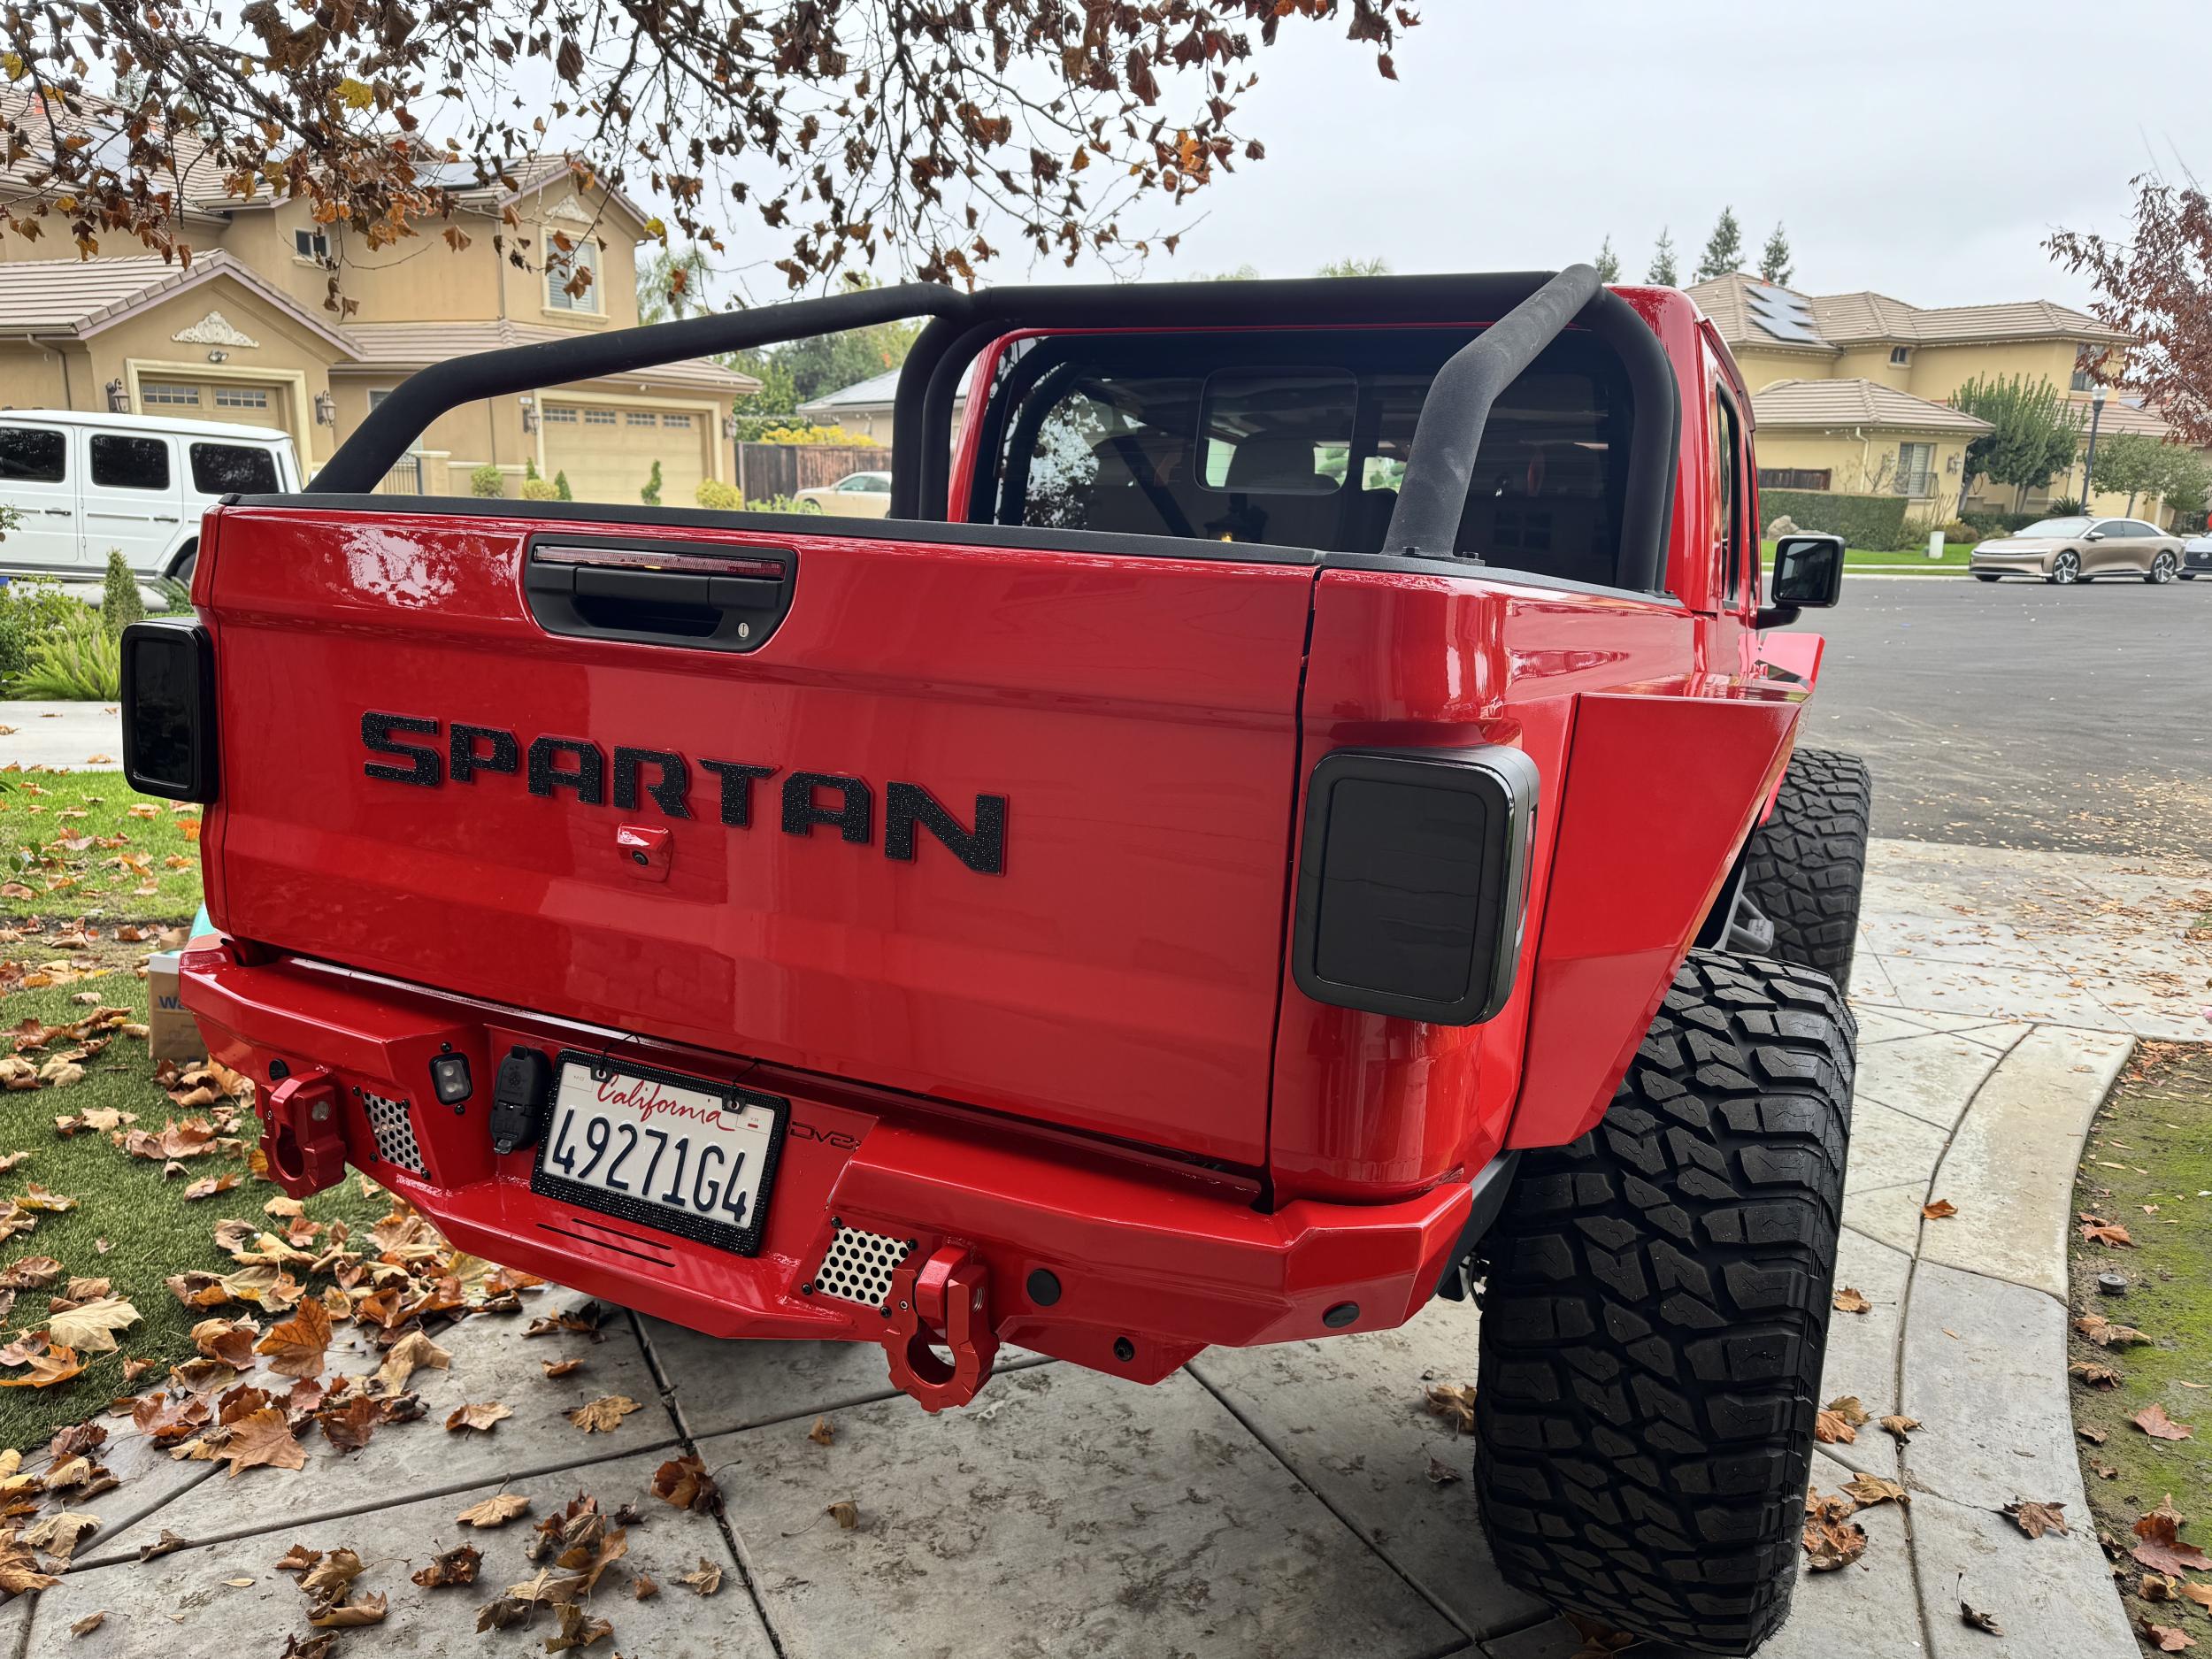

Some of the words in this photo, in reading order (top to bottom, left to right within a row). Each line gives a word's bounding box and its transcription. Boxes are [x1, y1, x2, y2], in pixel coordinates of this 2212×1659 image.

[361, 709, 1009, 876] SPARTAN
[597, 1072, 735, 1131] California
[552, 1109, 746, 1223] 49271G4
